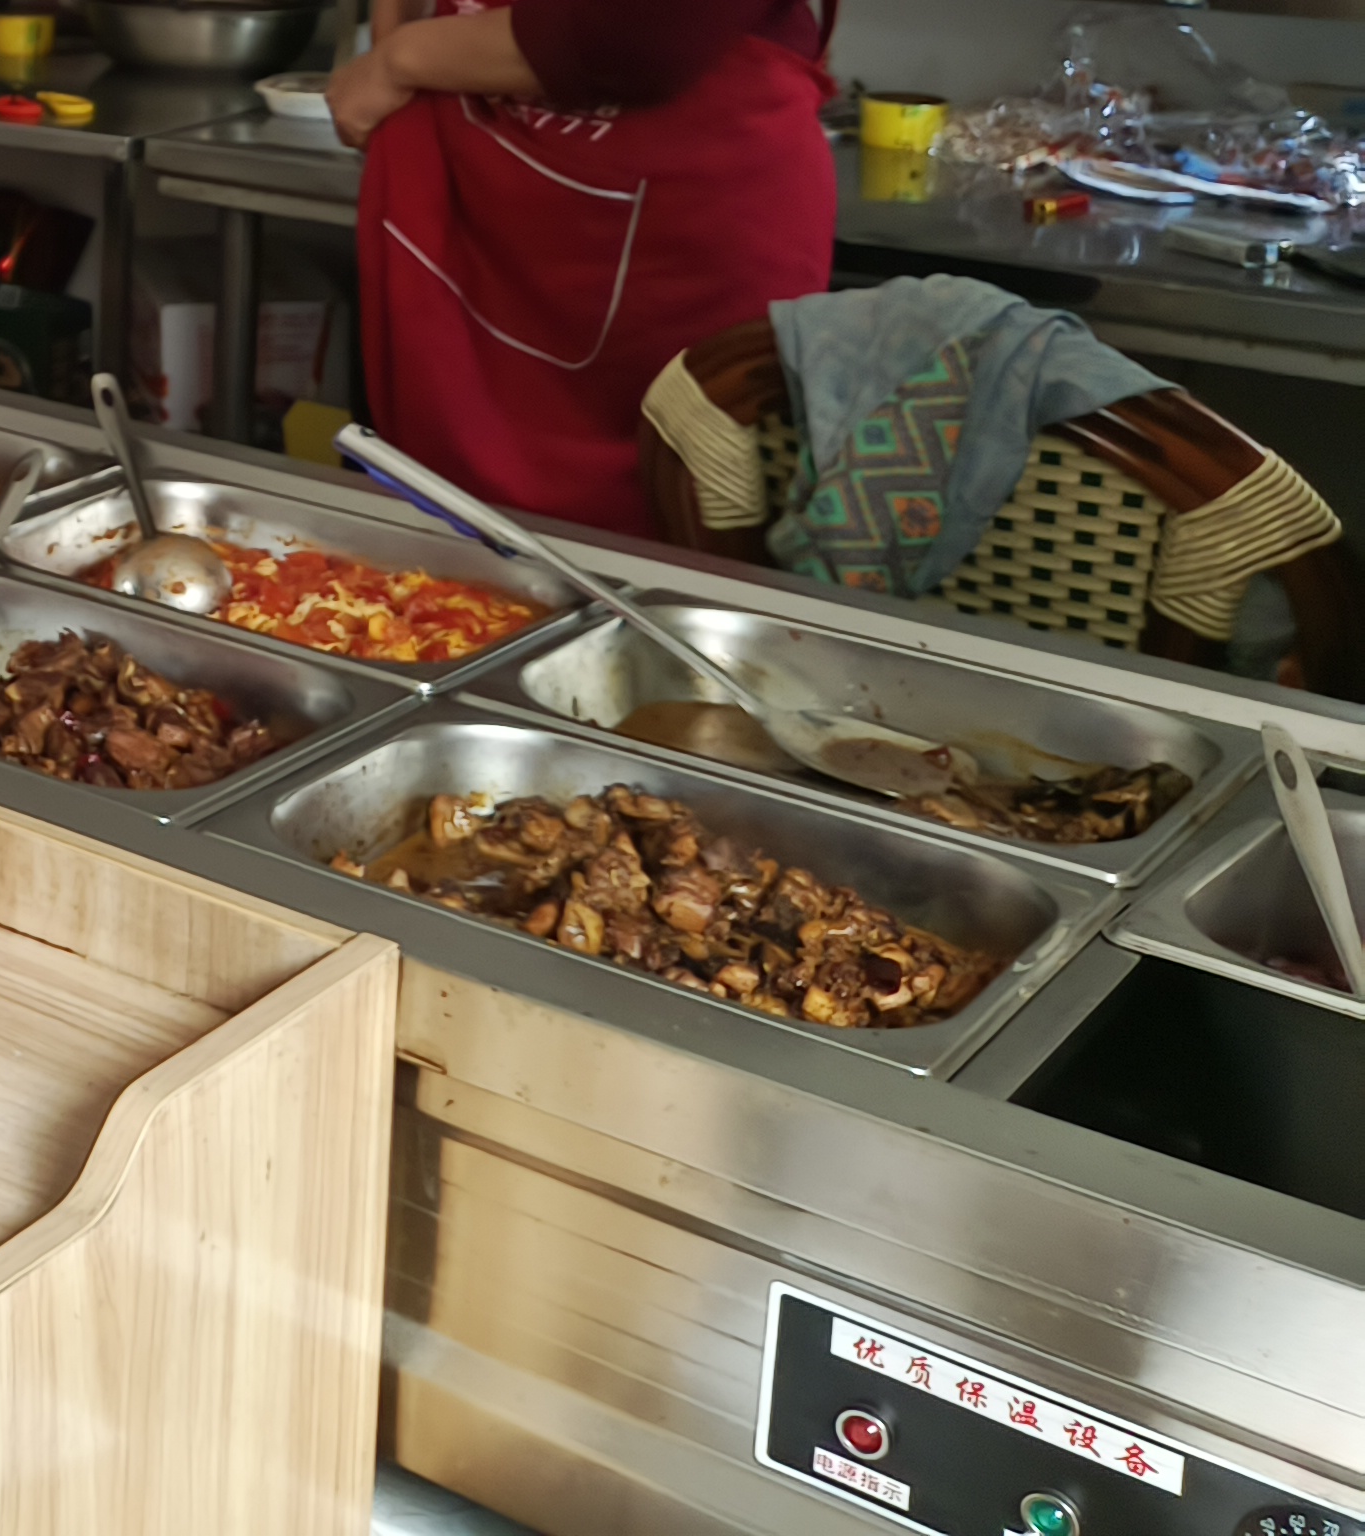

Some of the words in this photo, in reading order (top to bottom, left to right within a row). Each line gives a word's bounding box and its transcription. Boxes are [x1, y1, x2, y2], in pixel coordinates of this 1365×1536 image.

[851, 1335, 1159, 1480] 优质保温设备
[816, 1453, 903, 1503] 电源指示
